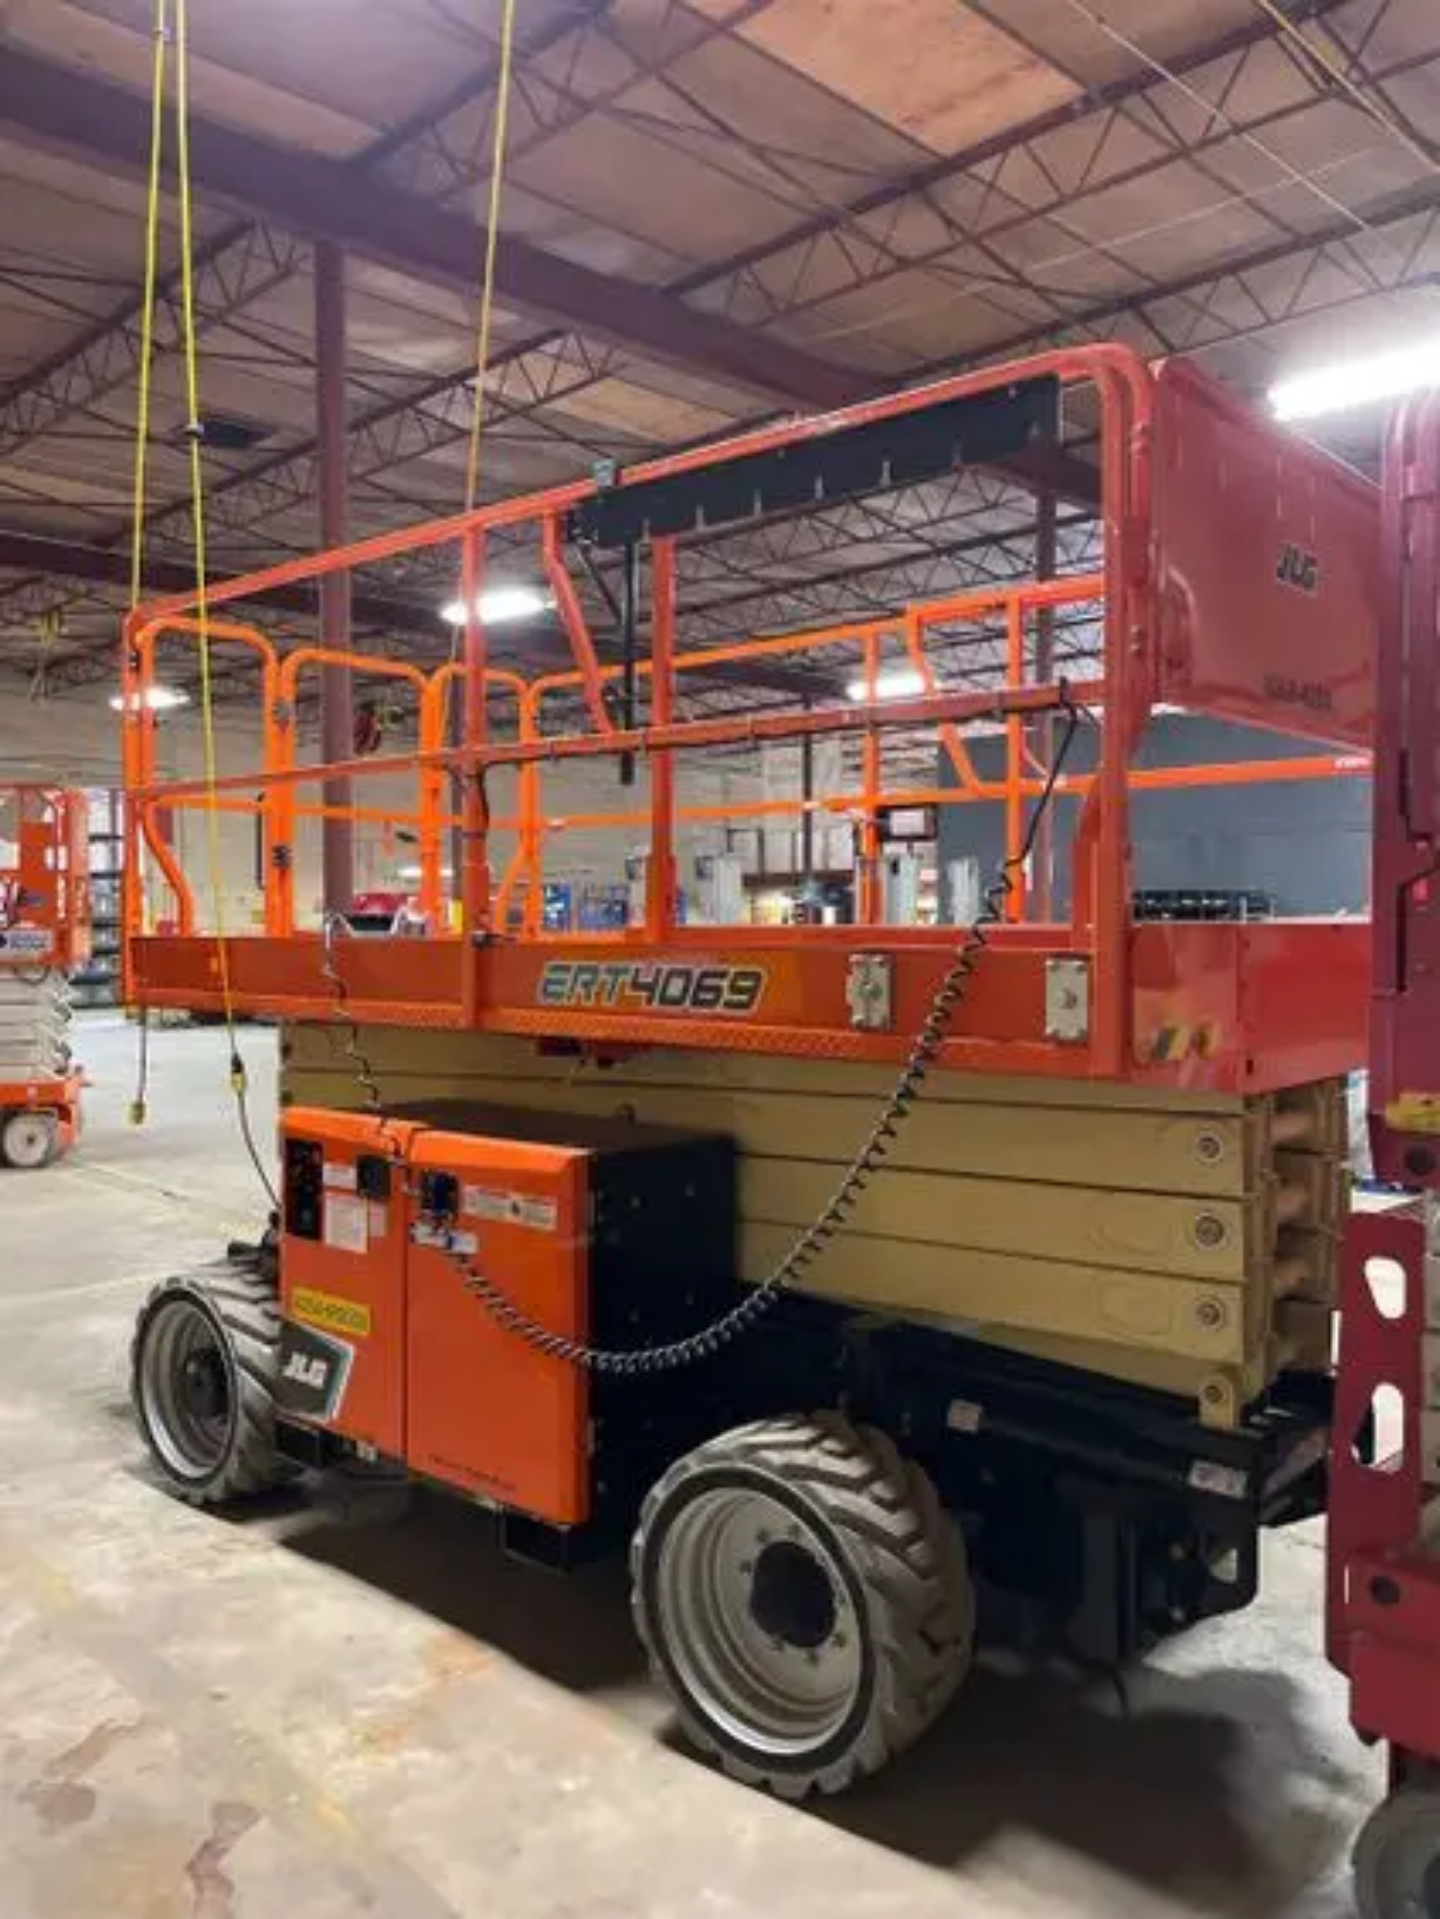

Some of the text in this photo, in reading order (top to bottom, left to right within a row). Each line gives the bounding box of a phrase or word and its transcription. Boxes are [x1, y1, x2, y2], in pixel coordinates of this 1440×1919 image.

[1277, 542, 1318, 592] JLG
[540, 963, 762, 1012] ERT4069
[282, 1353, 328, 1388] JLG
